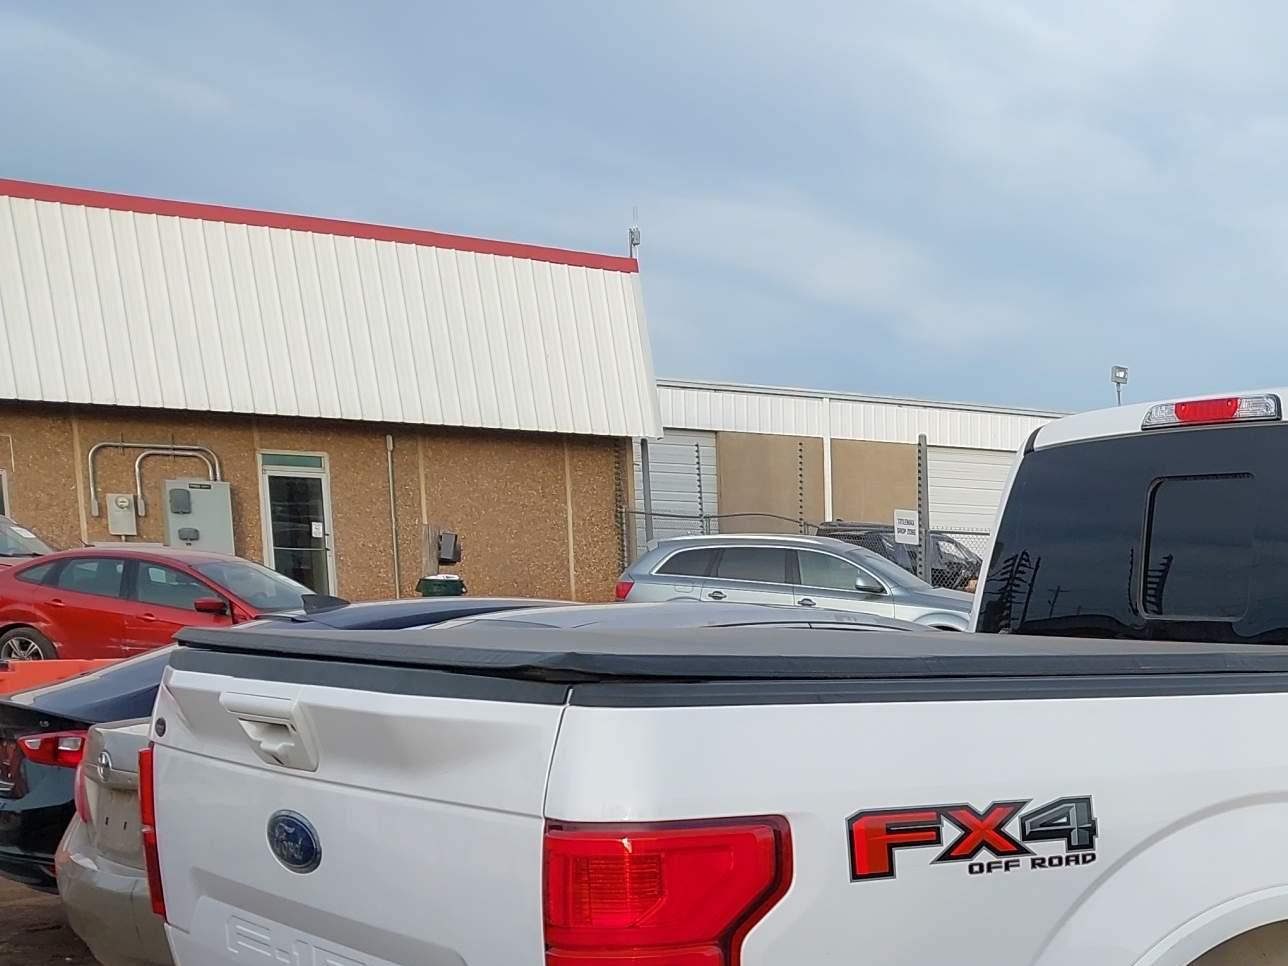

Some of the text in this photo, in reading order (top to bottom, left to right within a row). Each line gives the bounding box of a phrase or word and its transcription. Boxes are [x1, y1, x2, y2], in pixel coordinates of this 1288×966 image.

[845, 794, 1098, 883] FX4
[968, 852, 1097, 875] OFF ROAD
